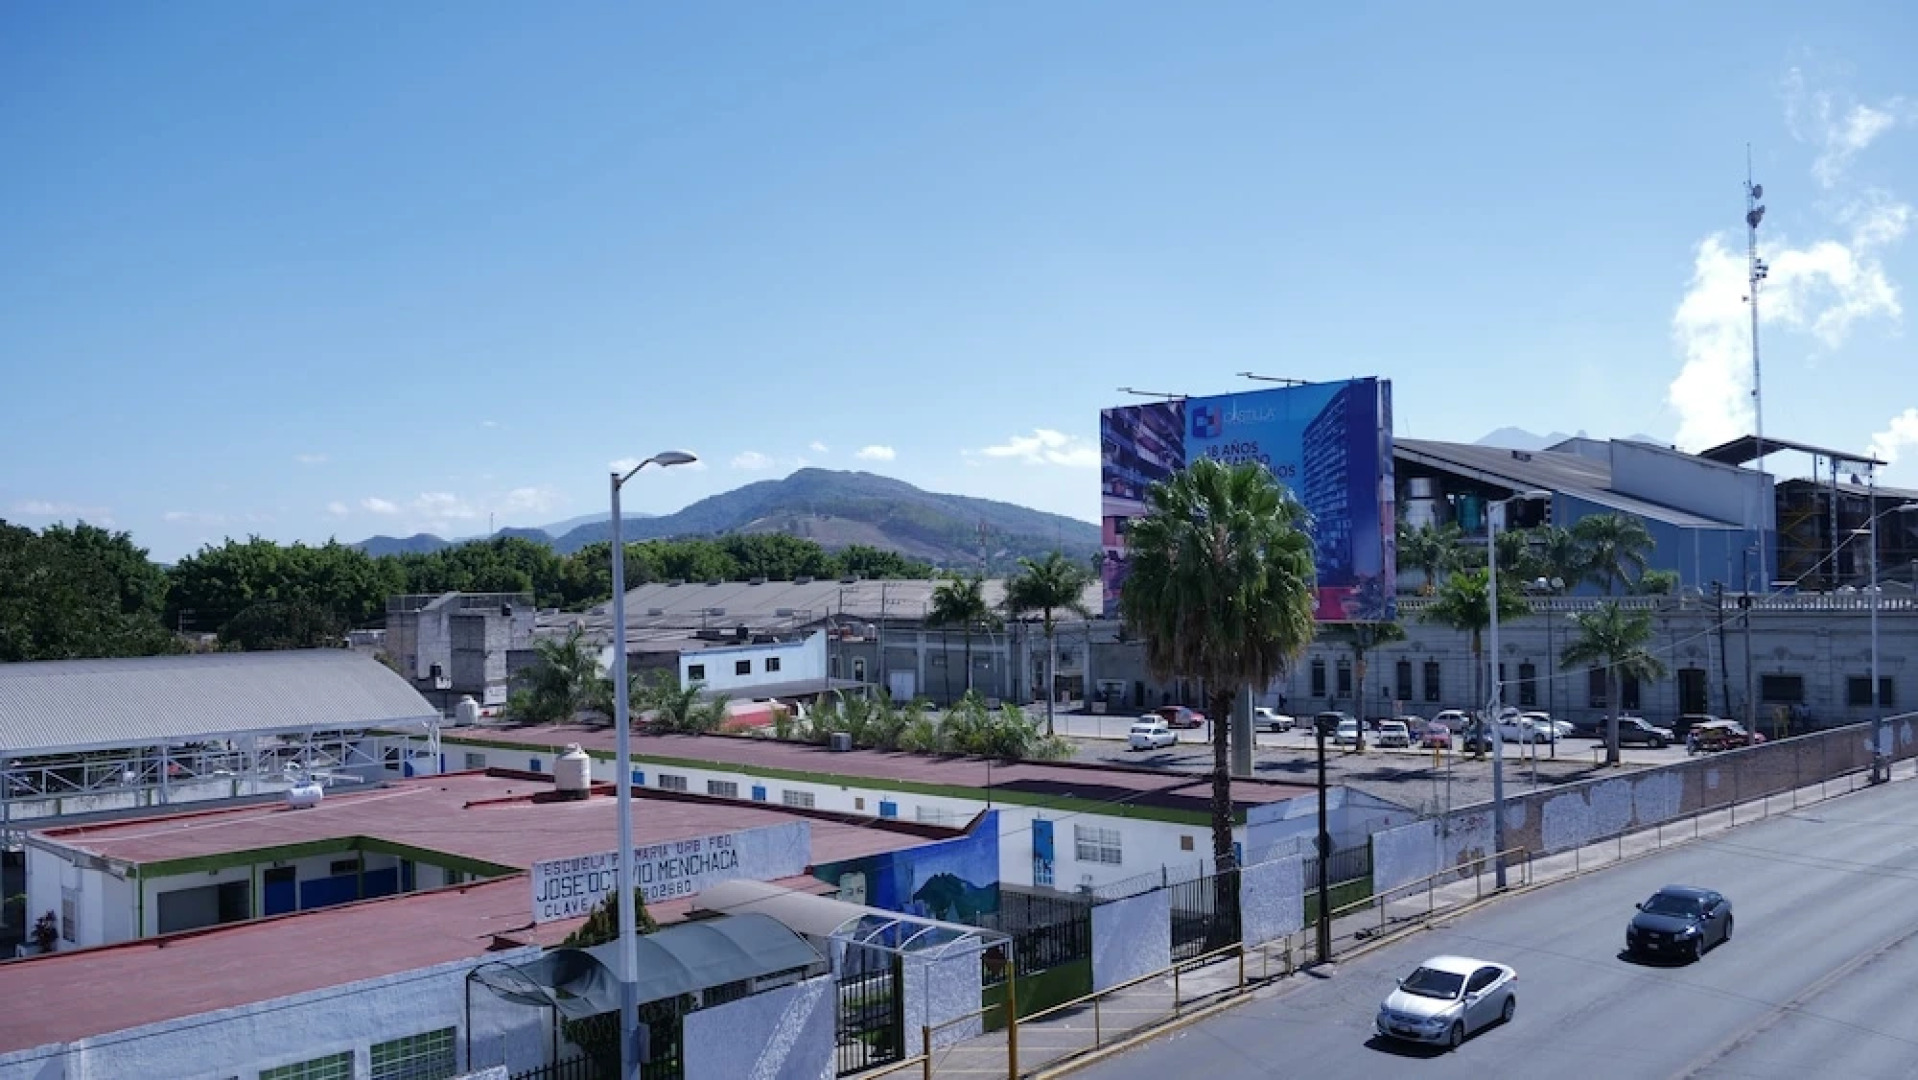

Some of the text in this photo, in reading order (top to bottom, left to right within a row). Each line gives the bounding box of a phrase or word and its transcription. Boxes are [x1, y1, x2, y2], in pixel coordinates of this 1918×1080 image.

[1222, 439, 1259, 456] AÑOS
[544, 855, 606, 876] ESCUELA
[611, 844, 669, 866] PMARIA
[676, 840, 701, 855] URB
[536, 874, 584, 903] JOSE
[657, 849, 740, 882] MENCHACA
[544, 897, 588, 918] CLAVE
